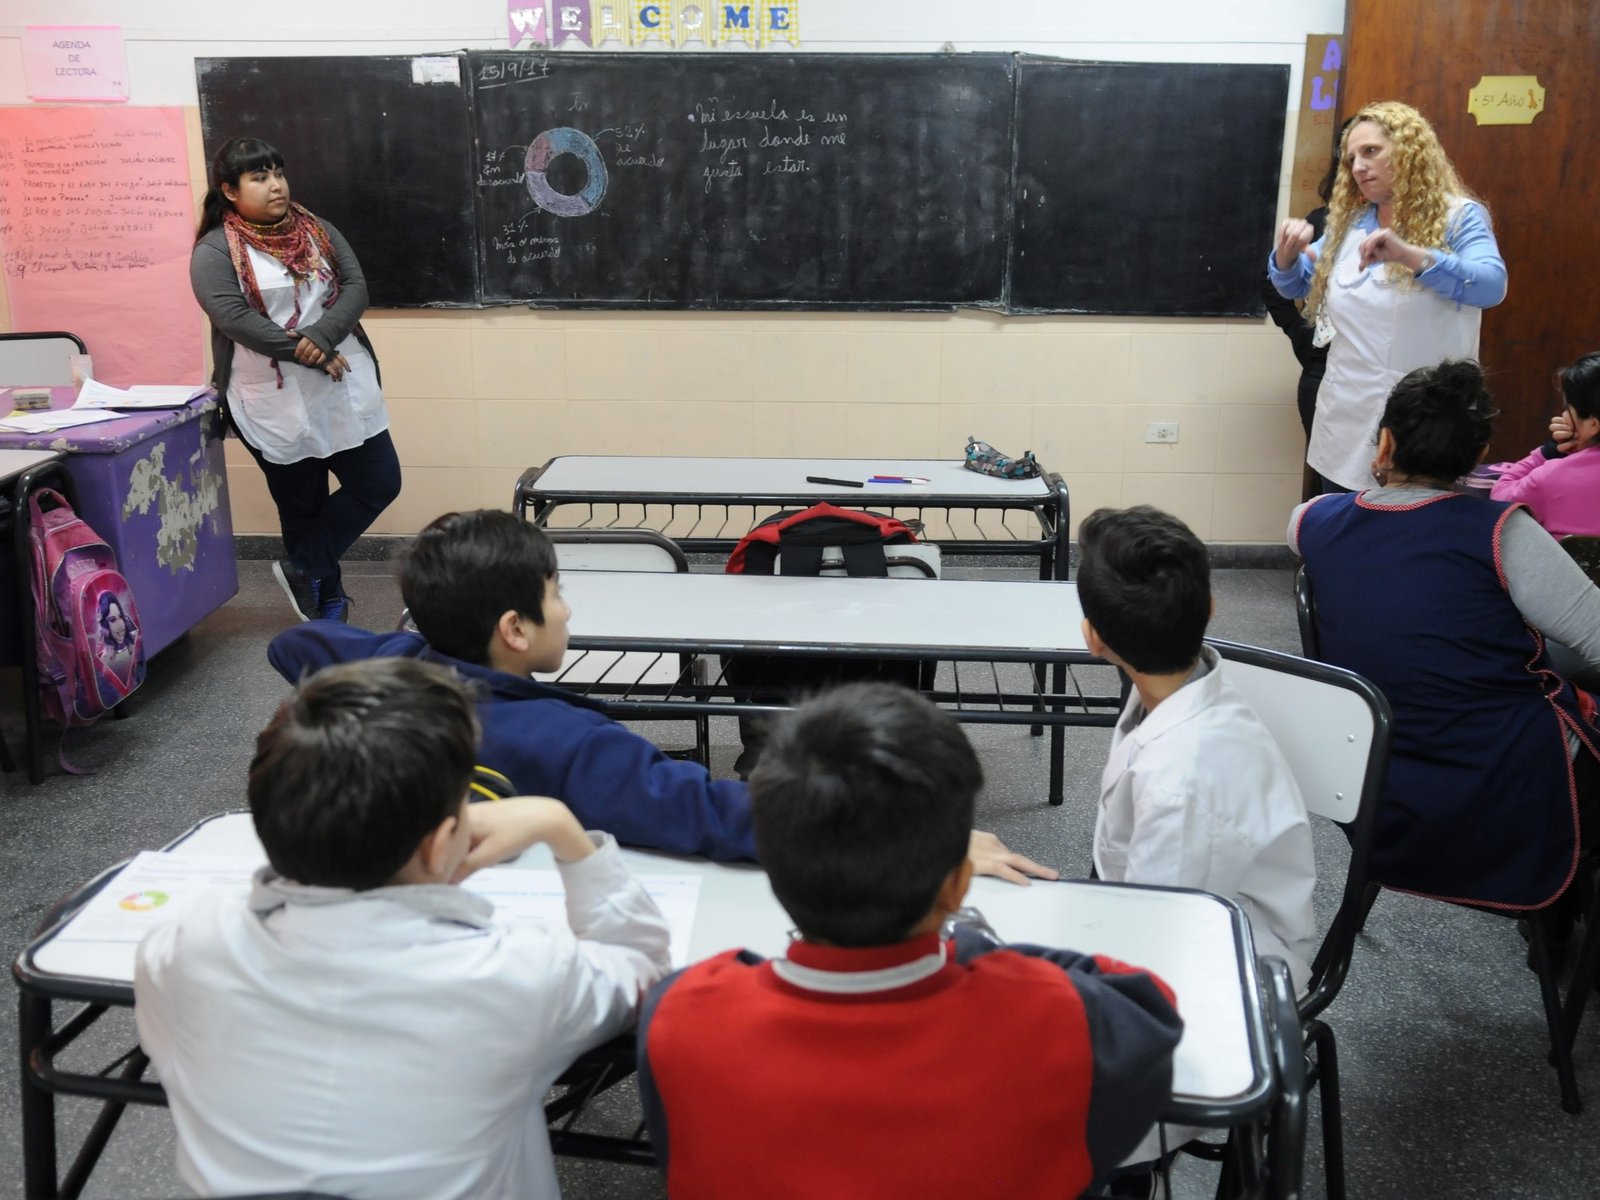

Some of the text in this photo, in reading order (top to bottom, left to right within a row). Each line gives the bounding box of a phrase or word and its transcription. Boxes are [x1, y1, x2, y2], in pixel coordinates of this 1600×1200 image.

[510, 5, 790, 31] WELCOME
[52, 40, 91, 49] AGENDA
[68, 54, 81, 63] DE
[55, 67, 97, 76] LECTURA
[1496, 92, 1525, 107] Año
[721, 99, 788, 122] escuela
[796, 109, 816, 123] es
[822, 111, 847, 123] un
[700, 126, 847, 164] lugar donde me
[703, 160, 743, 193] gusta
